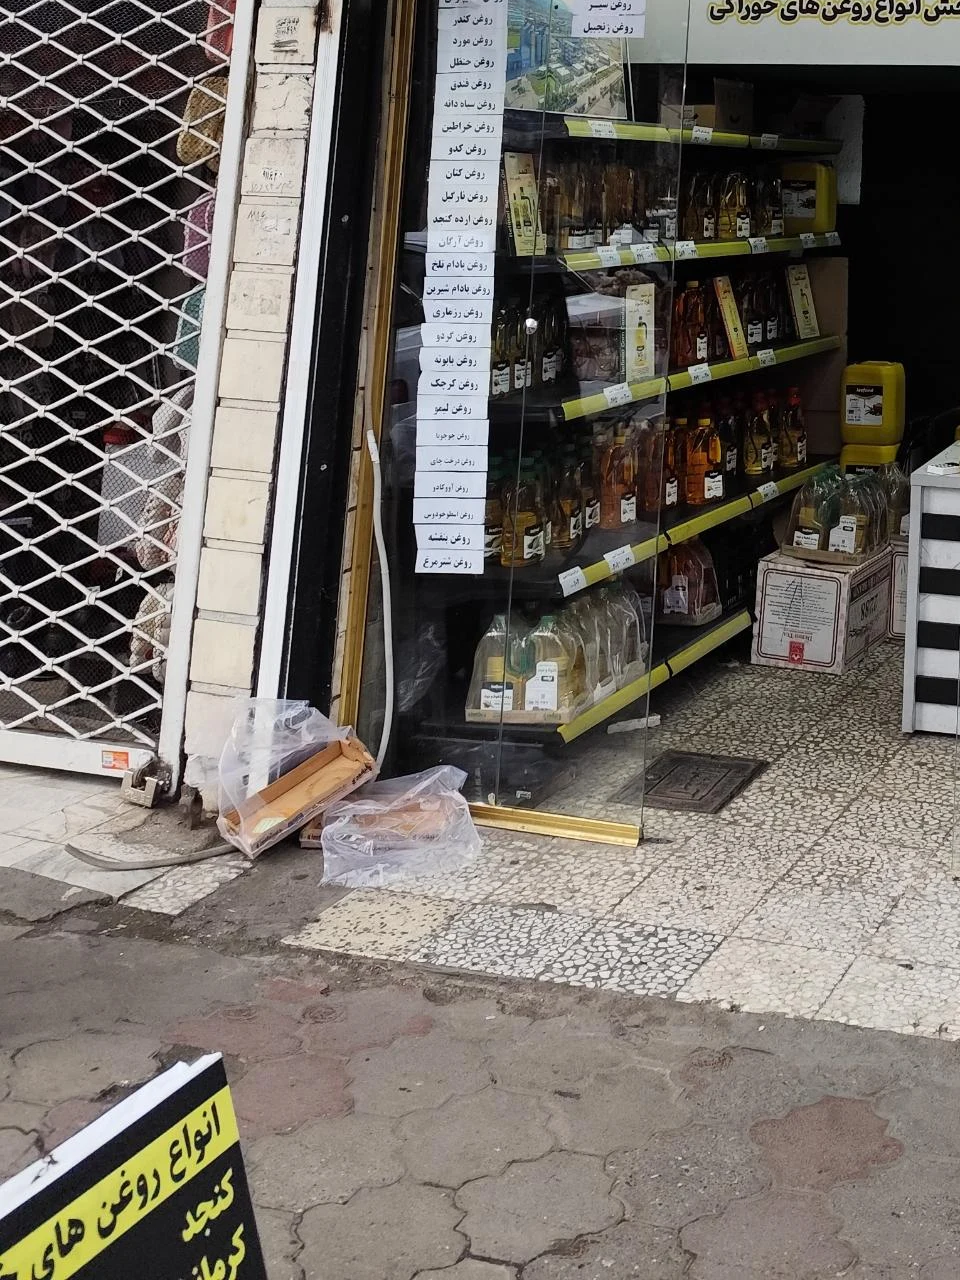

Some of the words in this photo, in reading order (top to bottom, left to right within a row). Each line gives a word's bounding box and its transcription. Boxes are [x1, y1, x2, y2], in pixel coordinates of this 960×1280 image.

[610, 0, 632, 11] روغن
[452, 15, 471, 26] کندر
[472, 15, 493, 26] روغن
[583, 22, 610, 34] زنجبیل
[612, 22, 634, 34] روغن
[473, 57, 495, 69] روغن
[474, 121, 495, 133] روغن
[447, 144, 464, 155] کدو
[465, 144, 487, 155] روغن
[472, 214, 493, 226] روغن
[471, 283, 491, 295] روغن
[463, 307, 483, 318] روغن
[458, 378, 479, 391] روغن
[451, 404, 472, 415] روغن
[168, 1101, 221, 1183] انواع
[97, 1167, 161, 1240] روغن
[181, 1167, 235, 1243] کنجد
[31, 1218, 85, 1280] های
